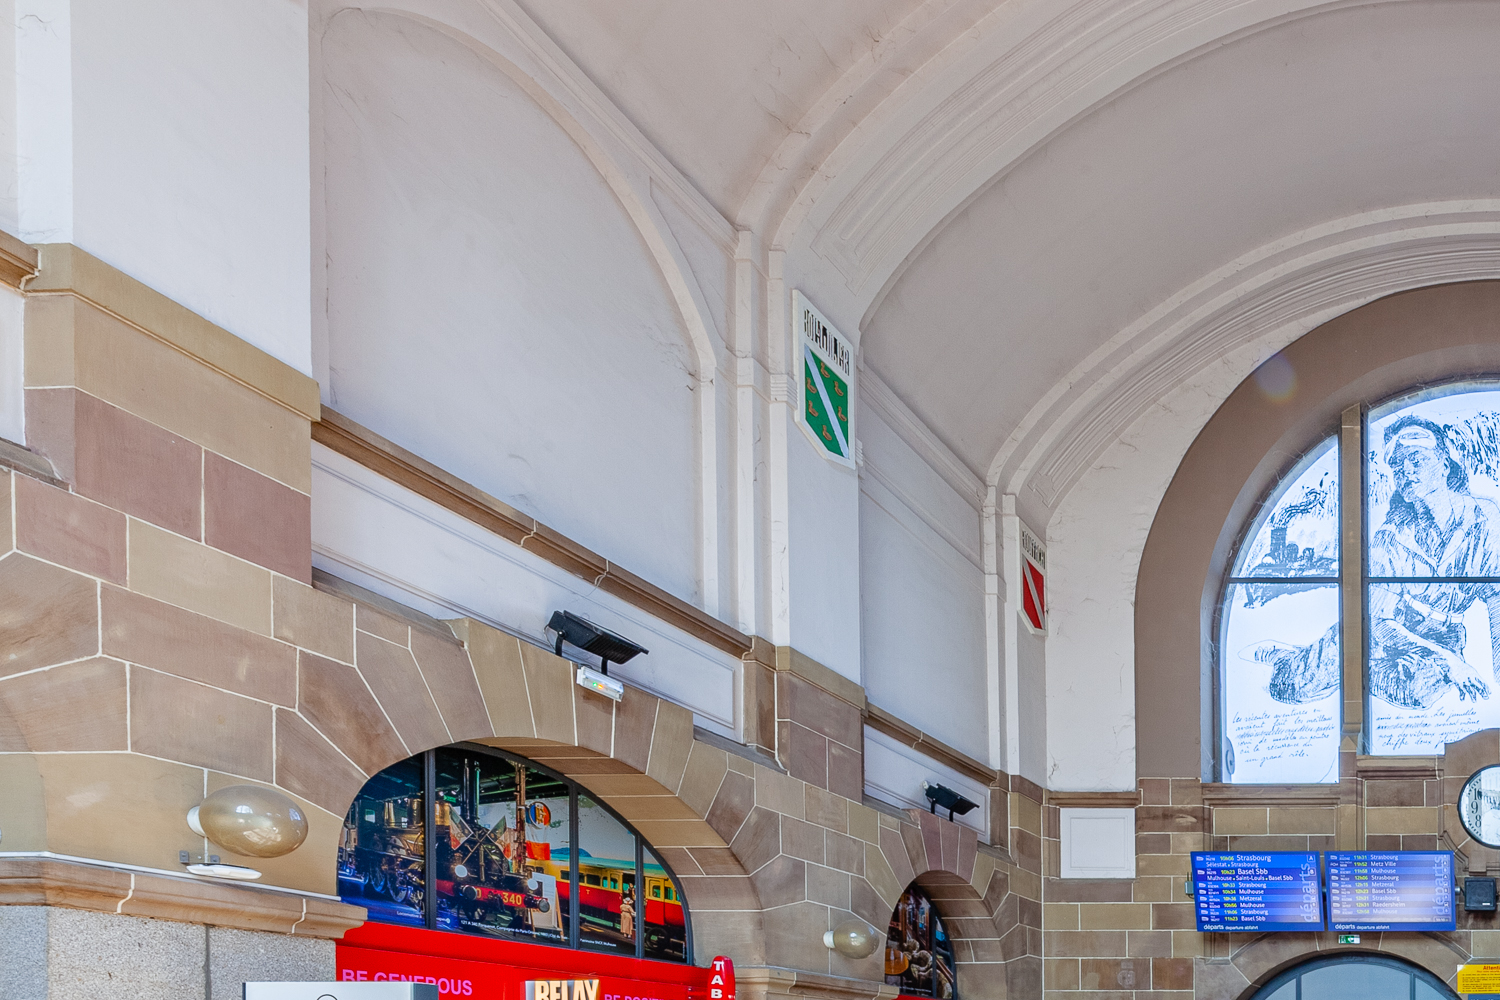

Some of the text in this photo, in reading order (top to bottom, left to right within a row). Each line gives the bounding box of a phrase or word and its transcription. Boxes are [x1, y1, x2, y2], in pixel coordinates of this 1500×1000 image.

[1471, 801, 1478, 814] 9
[1475, 815, 1481, 827] 8
[1432, 856, 1445, 915] départs
[1299, 863, 1314, 922] départs
[502, 893, 522, 905] 340
[342, 969, 367, 981] BE
